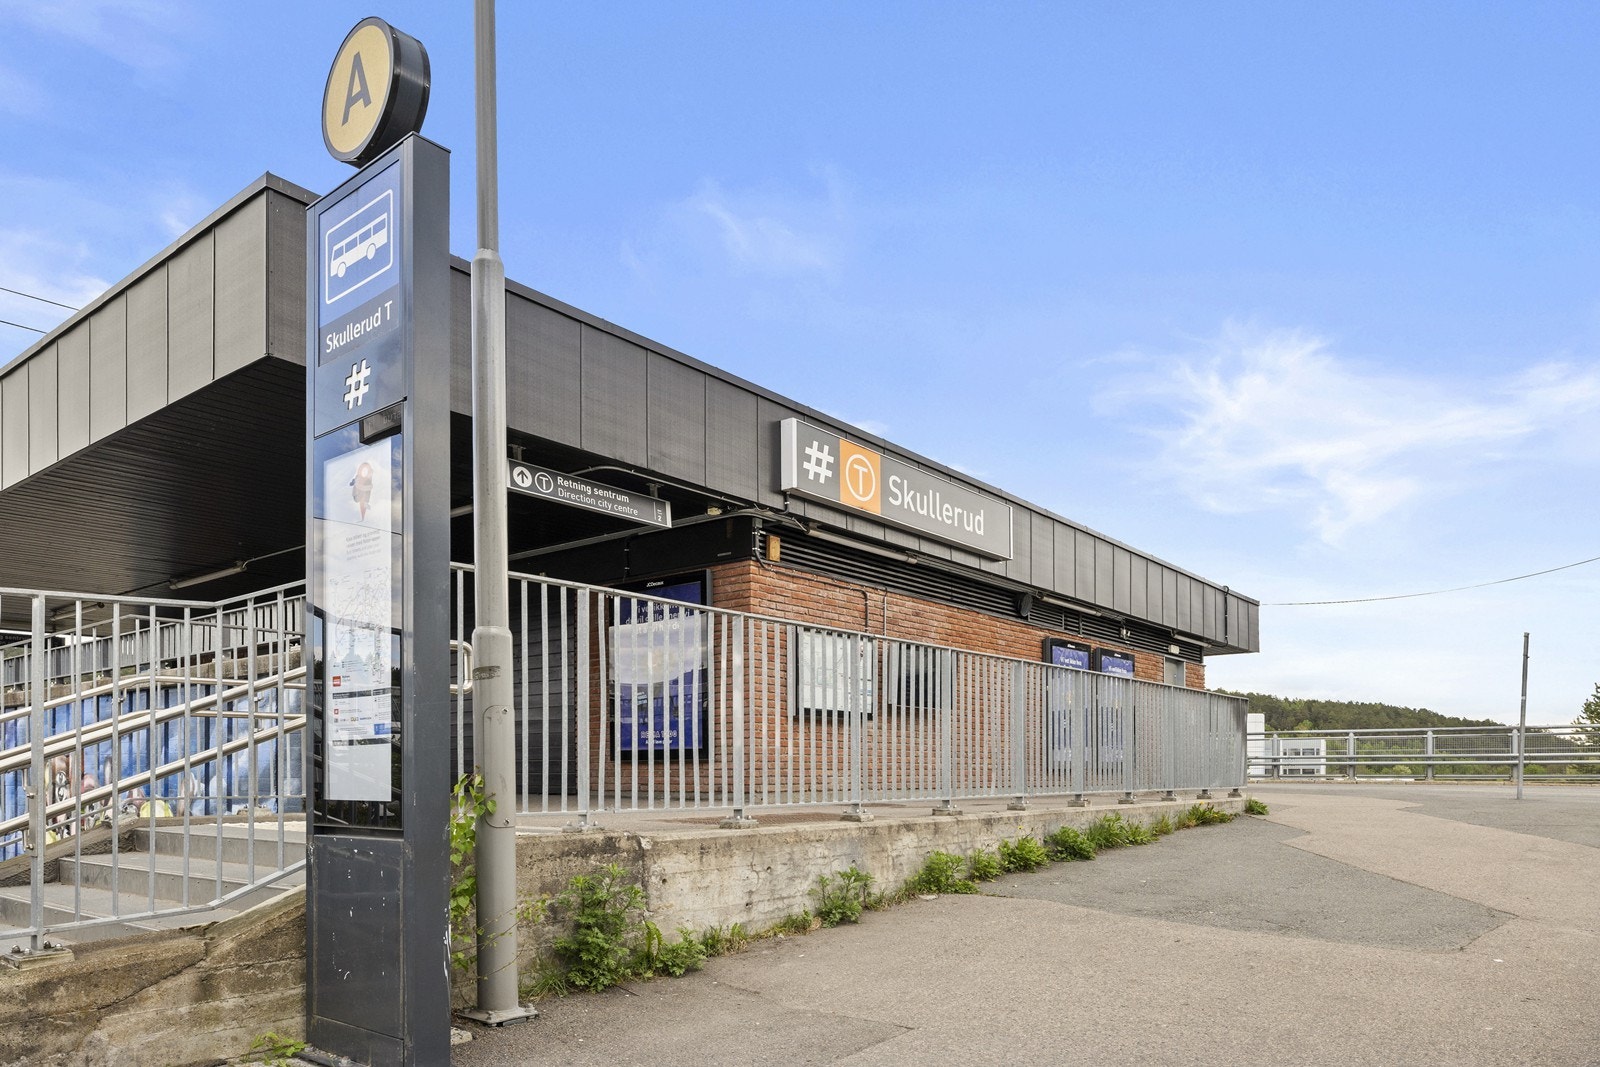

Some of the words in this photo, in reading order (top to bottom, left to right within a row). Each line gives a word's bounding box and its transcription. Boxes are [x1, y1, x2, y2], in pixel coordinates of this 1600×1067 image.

[341, 51, 372, 127] A
[326, 307, 381, 353] Skullerud
[384, 300, 393, 321] T
[557, 476, 592, 495] Retning
[593, 488, 629, 503] sentrum
[558, 488, 596, 505] Direction
[598, 499, 612, 510] city
[614, 504, 638, 516] centre
[888, 475, 985, 536] Skullerud
